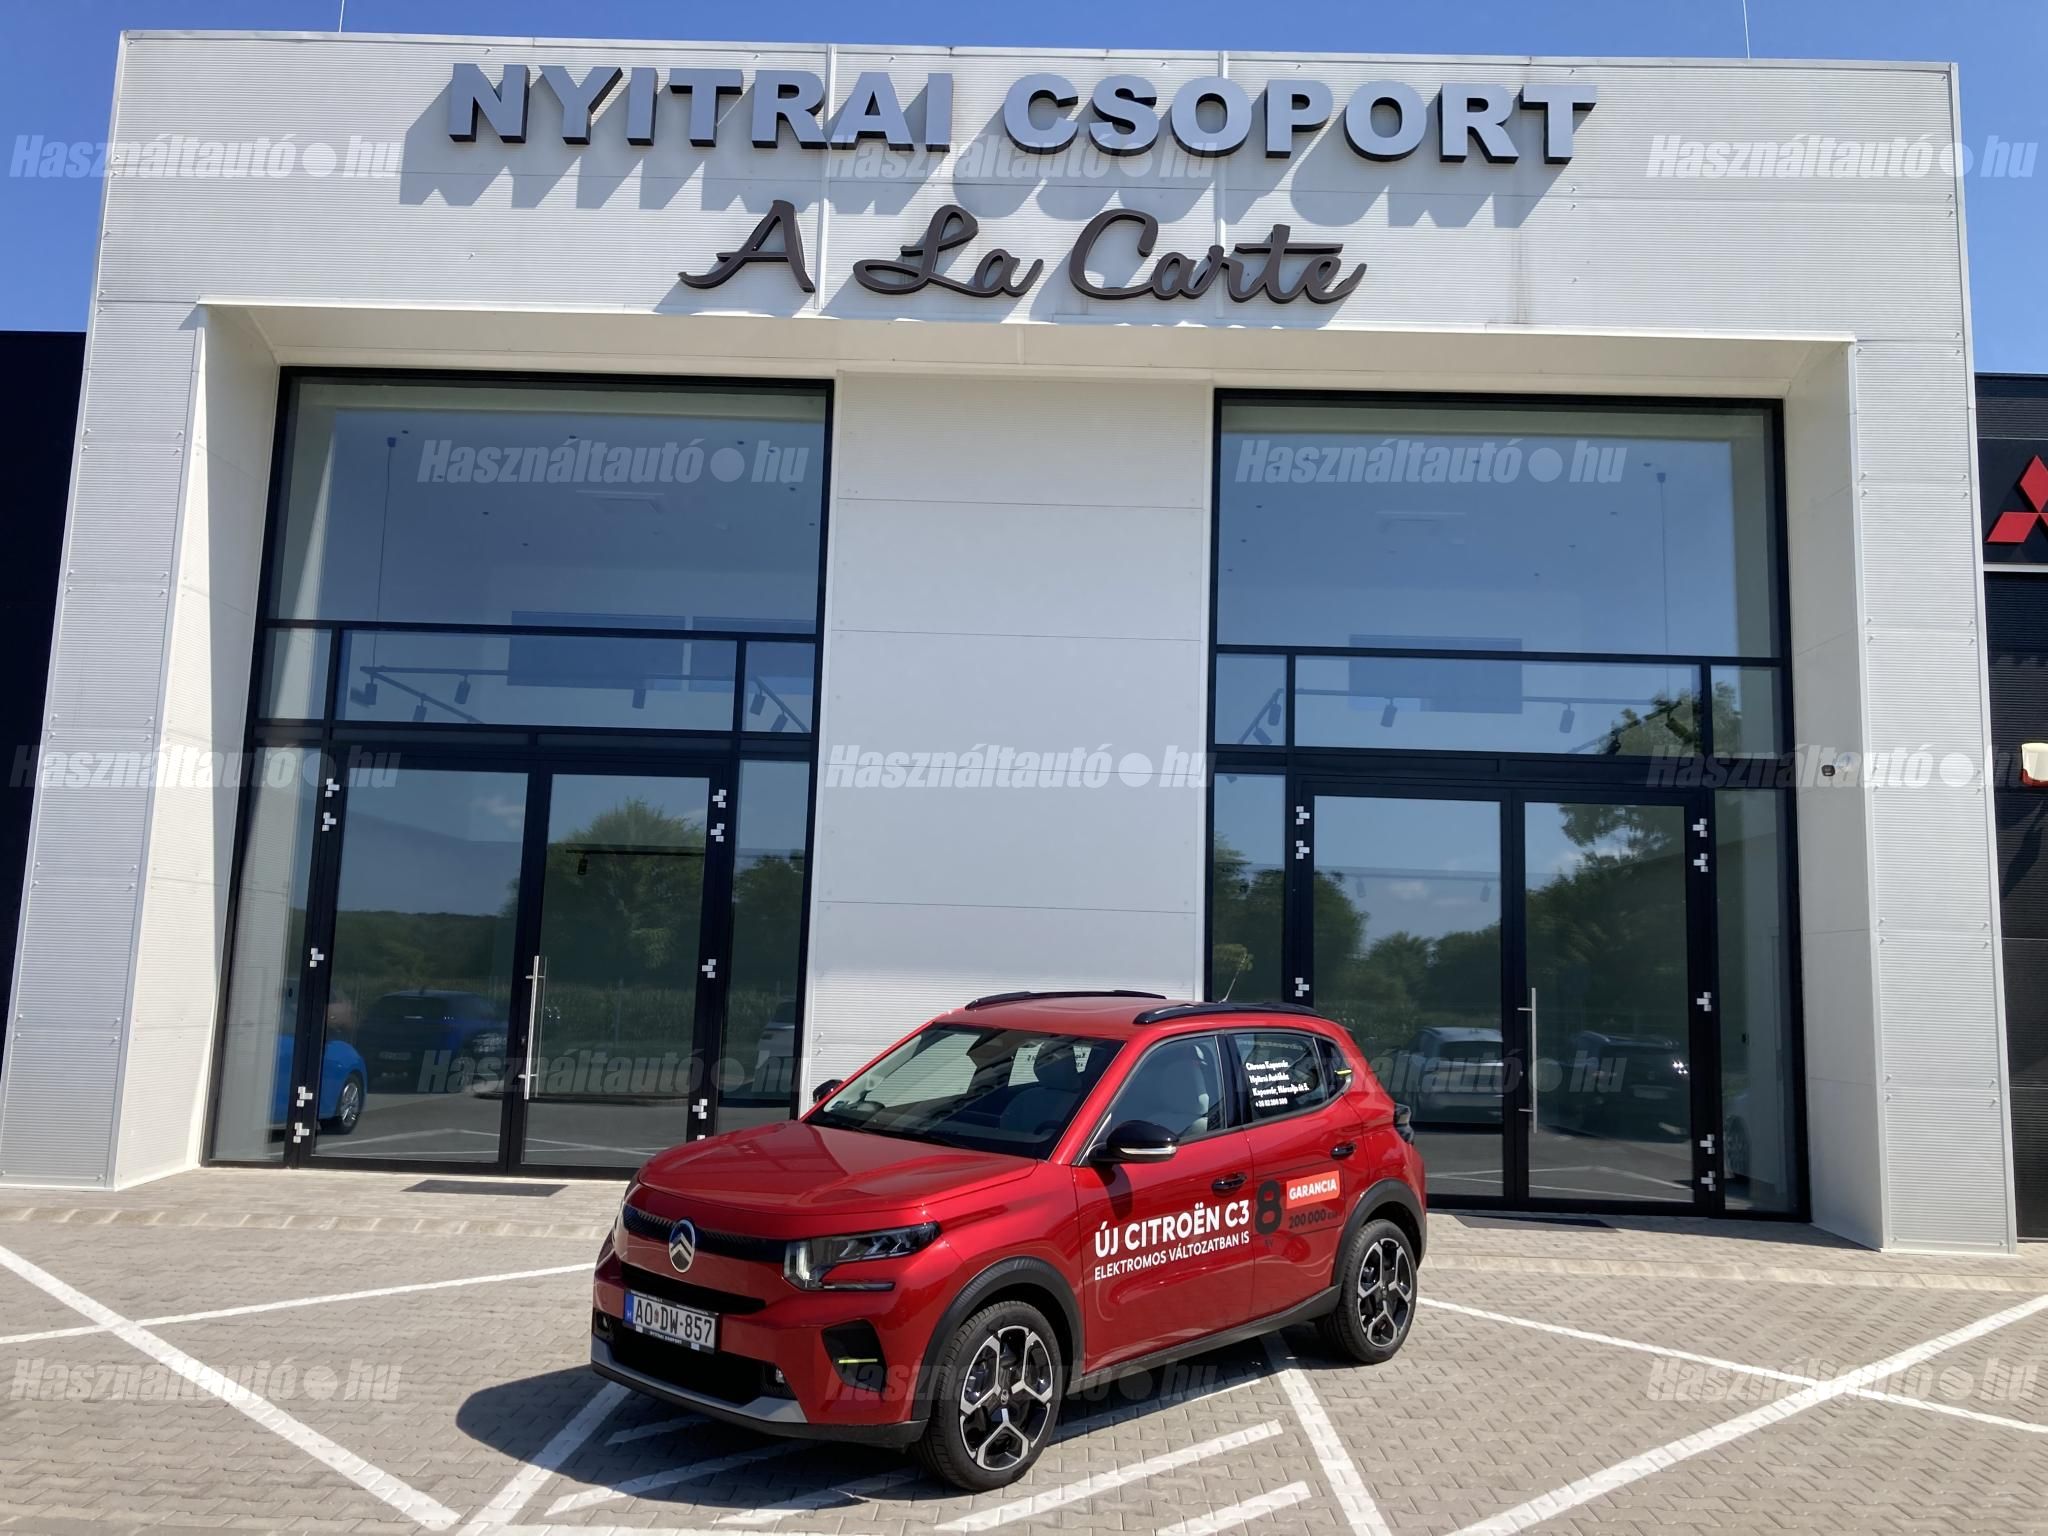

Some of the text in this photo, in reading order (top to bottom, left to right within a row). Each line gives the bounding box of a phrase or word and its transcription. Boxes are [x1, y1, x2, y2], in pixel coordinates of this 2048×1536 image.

[449, 63, 1597, 164] NYITRAI CSOPORT
[677, 200, 1367, 303] A La Carte
[1255, 1180, 1282, 1235] 8
[1289, 1178, 1337, 1200] GARANCIA
[1095, 1199, 1250, 1258] ÚJ CITROËN C3
[1095, 1231, 1250, 1281] ELEKTROMOS VÁLTOZATBAN IS
[660, 1306, 712, 1344] DW-857
